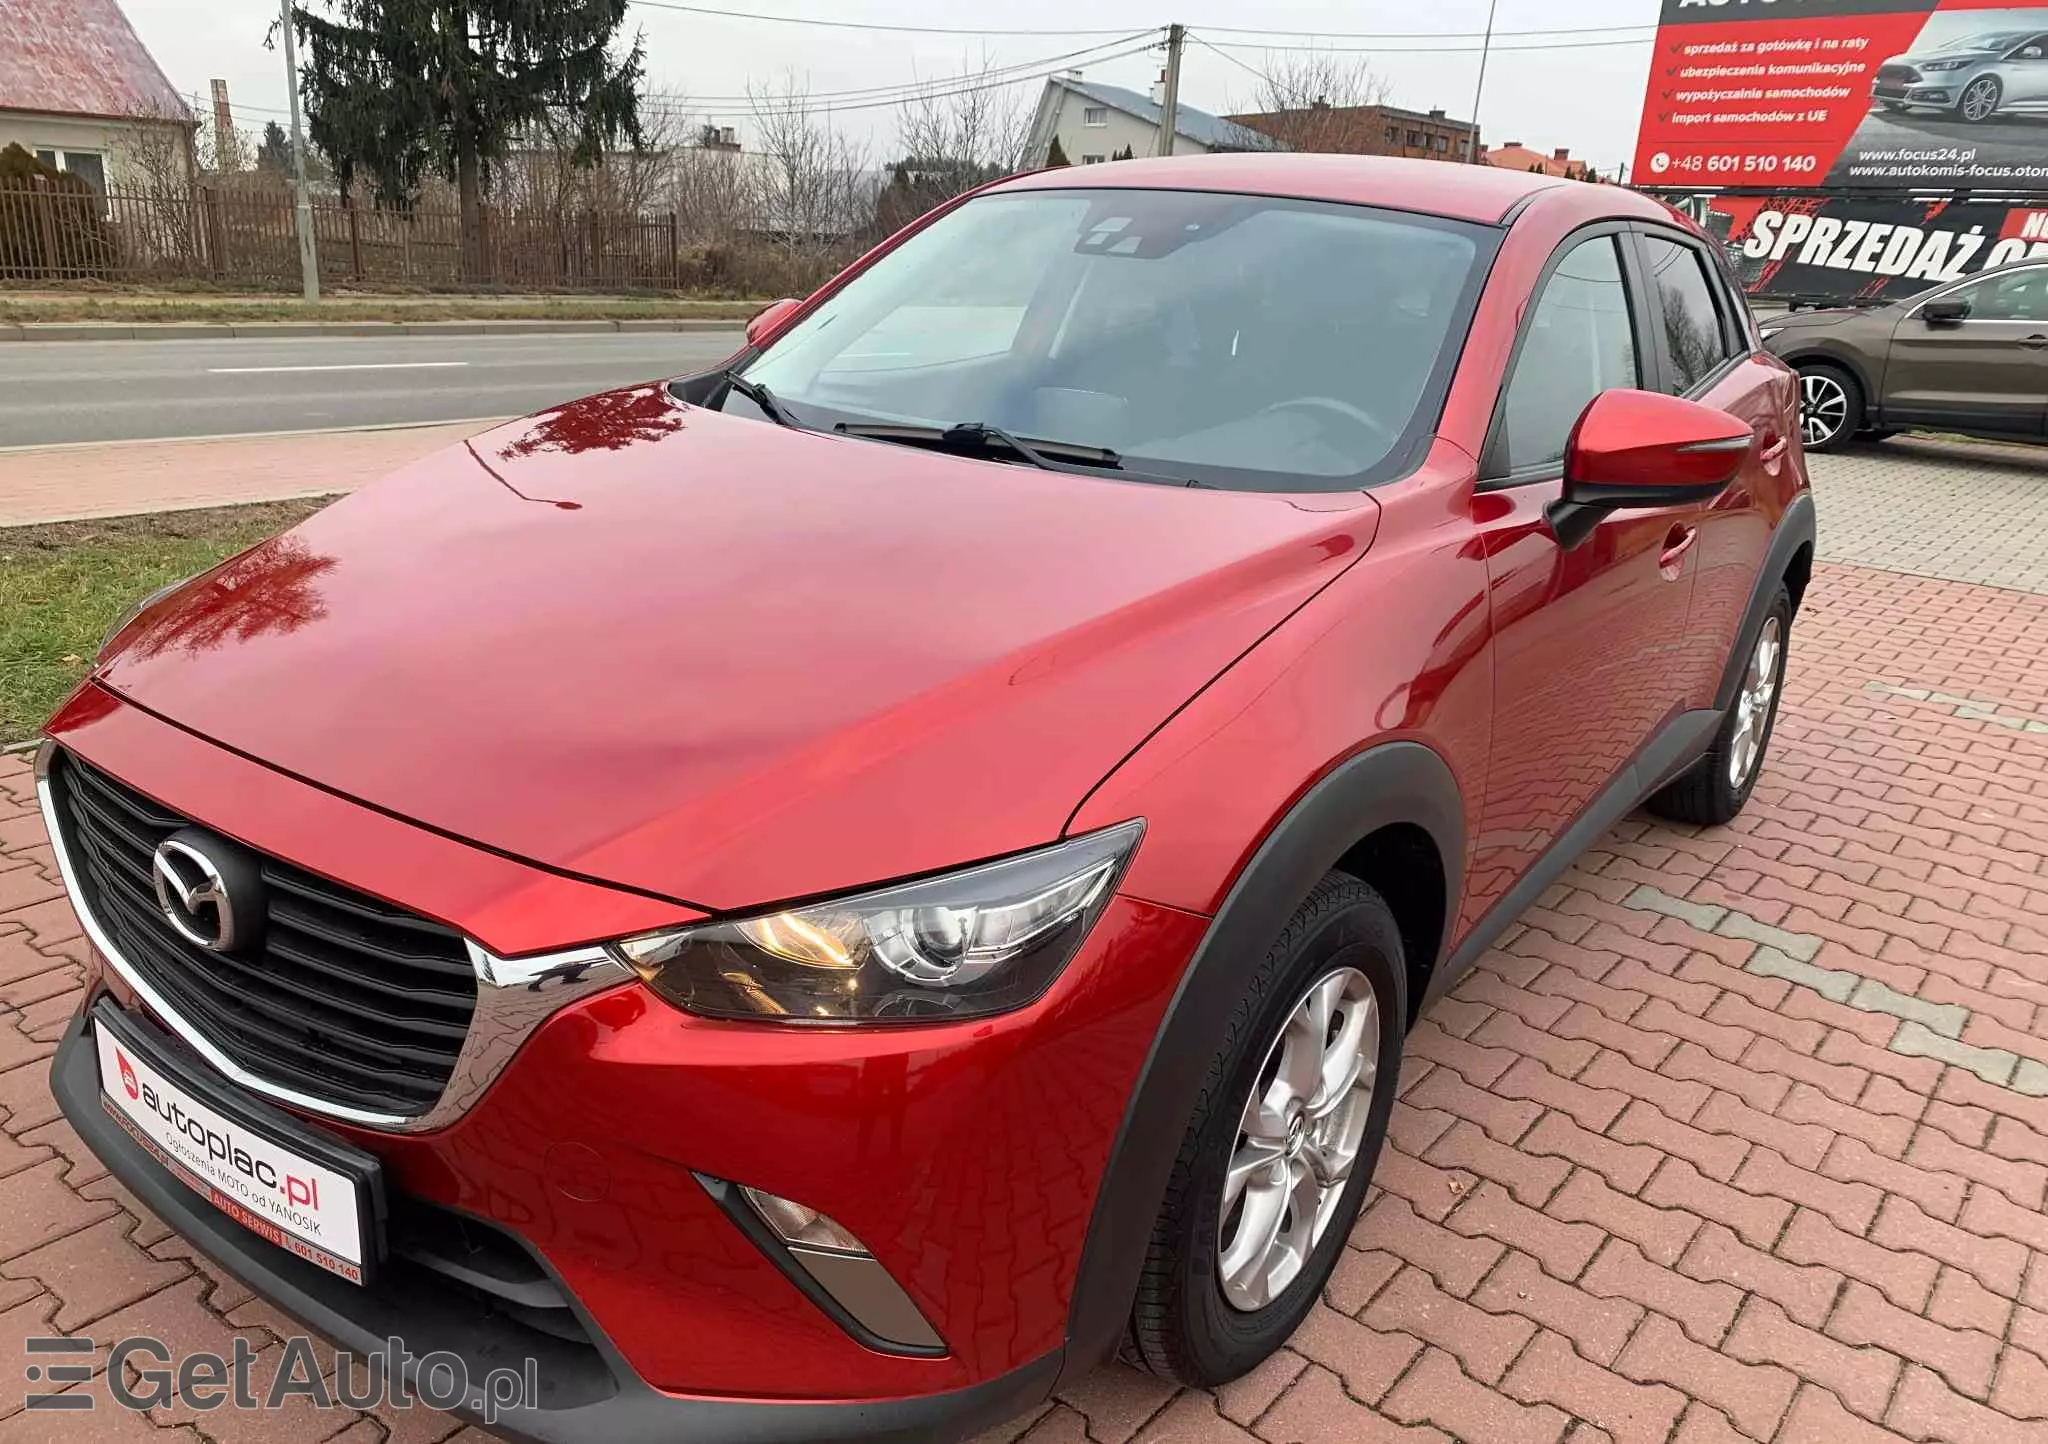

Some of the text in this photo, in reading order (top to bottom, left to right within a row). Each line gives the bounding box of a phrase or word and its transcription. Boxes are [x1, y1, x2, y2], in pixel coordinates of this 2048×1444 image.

[1683, 40, 1739, 56] sprzedaż
[1740, 41, 1755, 53] za
[1757, 38, 1812, 55] gotówkę
[1822, 38, 1839, 49] na
[1841, 36, 1870, 51] raty
[1679, 60, 1866, 80] ubezpieczenia komunikacyjne
[1675, 85, 1852, 103] wypożyczalnia samochodów
[1713, 109, 1794, 123] samochodów
[1795, 113, 1805, 122] z
[1807, 109, 1828, 121] UE
[1672, 155, 1817, 172] +48 601 510 140
[1859, 148, 1976, 163] www.focus24.pl
[1743, 210, 1986, 282] SPRZEDAŻ
[142, 1082, 320, 1211] autoplac.pl
[165, 1130, 216, 1178] Ogłoszenia
[216, 1168, 250, 1198] MOTO
[251, 1191, 267, 1209] od
[213, 1193, 241, 1221] AUTO
[241, 1211, 281, 1243] SERWIS
[294, 1242, 314, 1261] 601
[338, 1262, 359, 1282] 140
